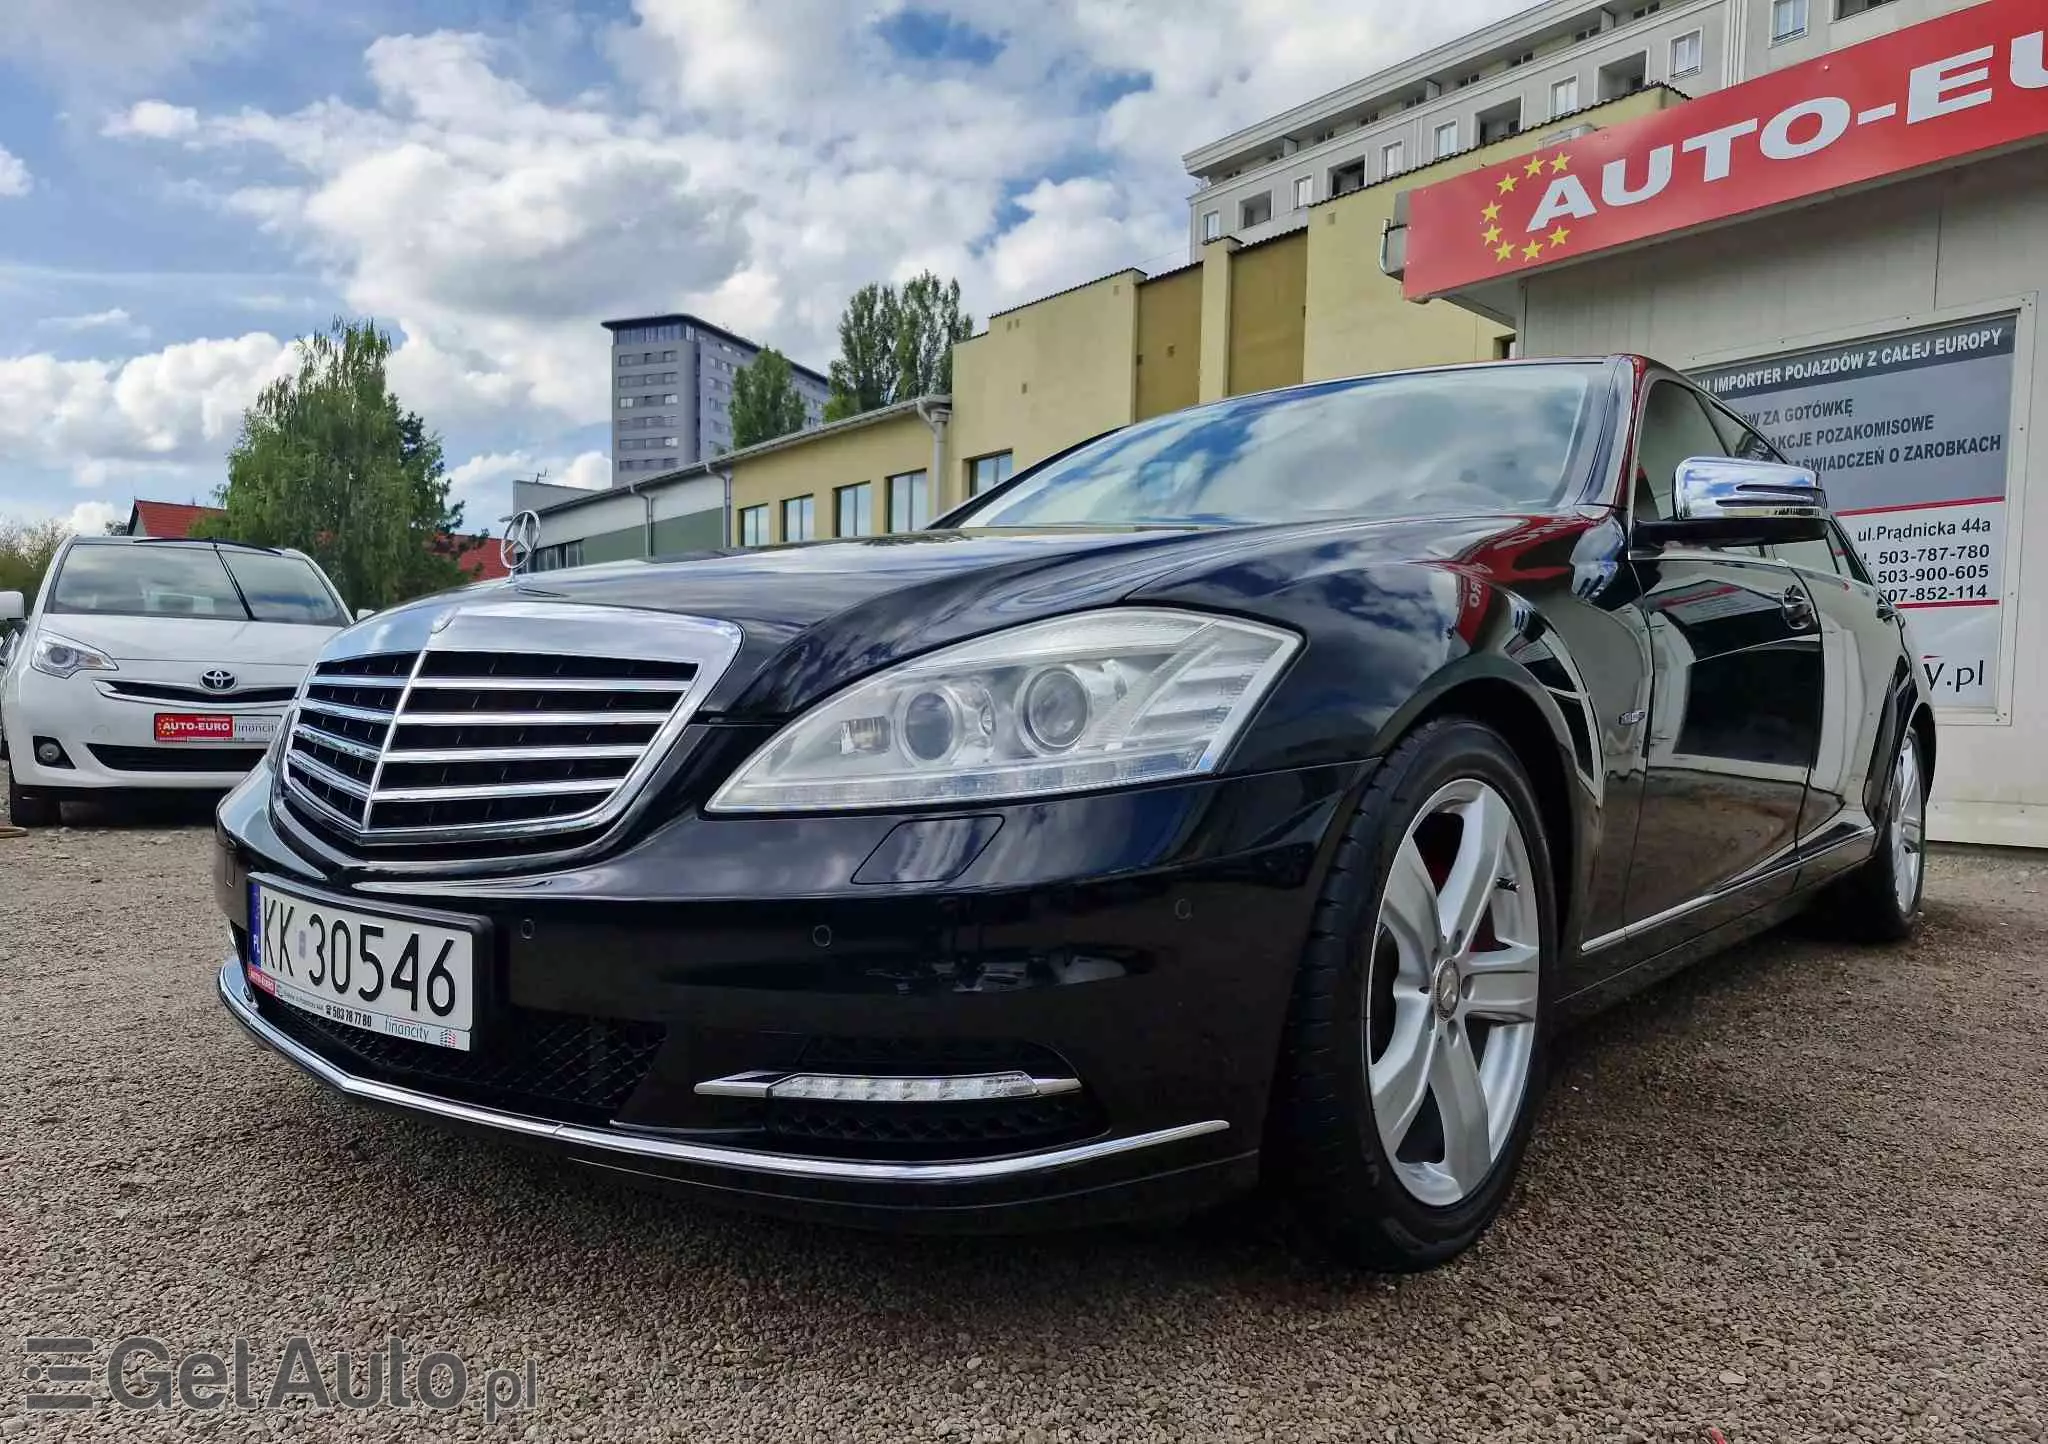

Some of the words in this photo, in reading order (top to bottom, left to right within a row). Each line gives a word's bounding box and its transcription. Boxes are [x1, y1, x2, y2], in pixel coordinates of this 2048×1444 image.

[1714, 367, 1781, 393] IMPORTER
[1785, 351, 1864, 381] POJAZDÓW
[1866, 350, 1878, 368] Z
[1881, 340, 1931, 365] CAŁEJ
[1935, 327, 2002, 356] EUROPY
[1763, 409, 1780, 426] ZA
[1784, 399, 1853, 421] GOTÓWKĘ
[1816, 414, 1934, 446] POZAKOMISOWE
[1889, 447, 1900, 463] O
[1903, 434, 2001, 462] ZAROBKACH
[1858, 521, 1956, 542] ul.Prądnicka
[1961, 518, 1991, 534] 44a
[1879, 544, 1990, 565] 503-787-780
[1877, 564, 1989, 584] 503-900-605
[162, 721, 231, 732] AUTO-EURO
[264, 895, 295, 977] KK
[308, 912, 456, 1017] 30546
[332, 1005, 345, 1020] 503
[384, 1014, 430, 1041] financity
